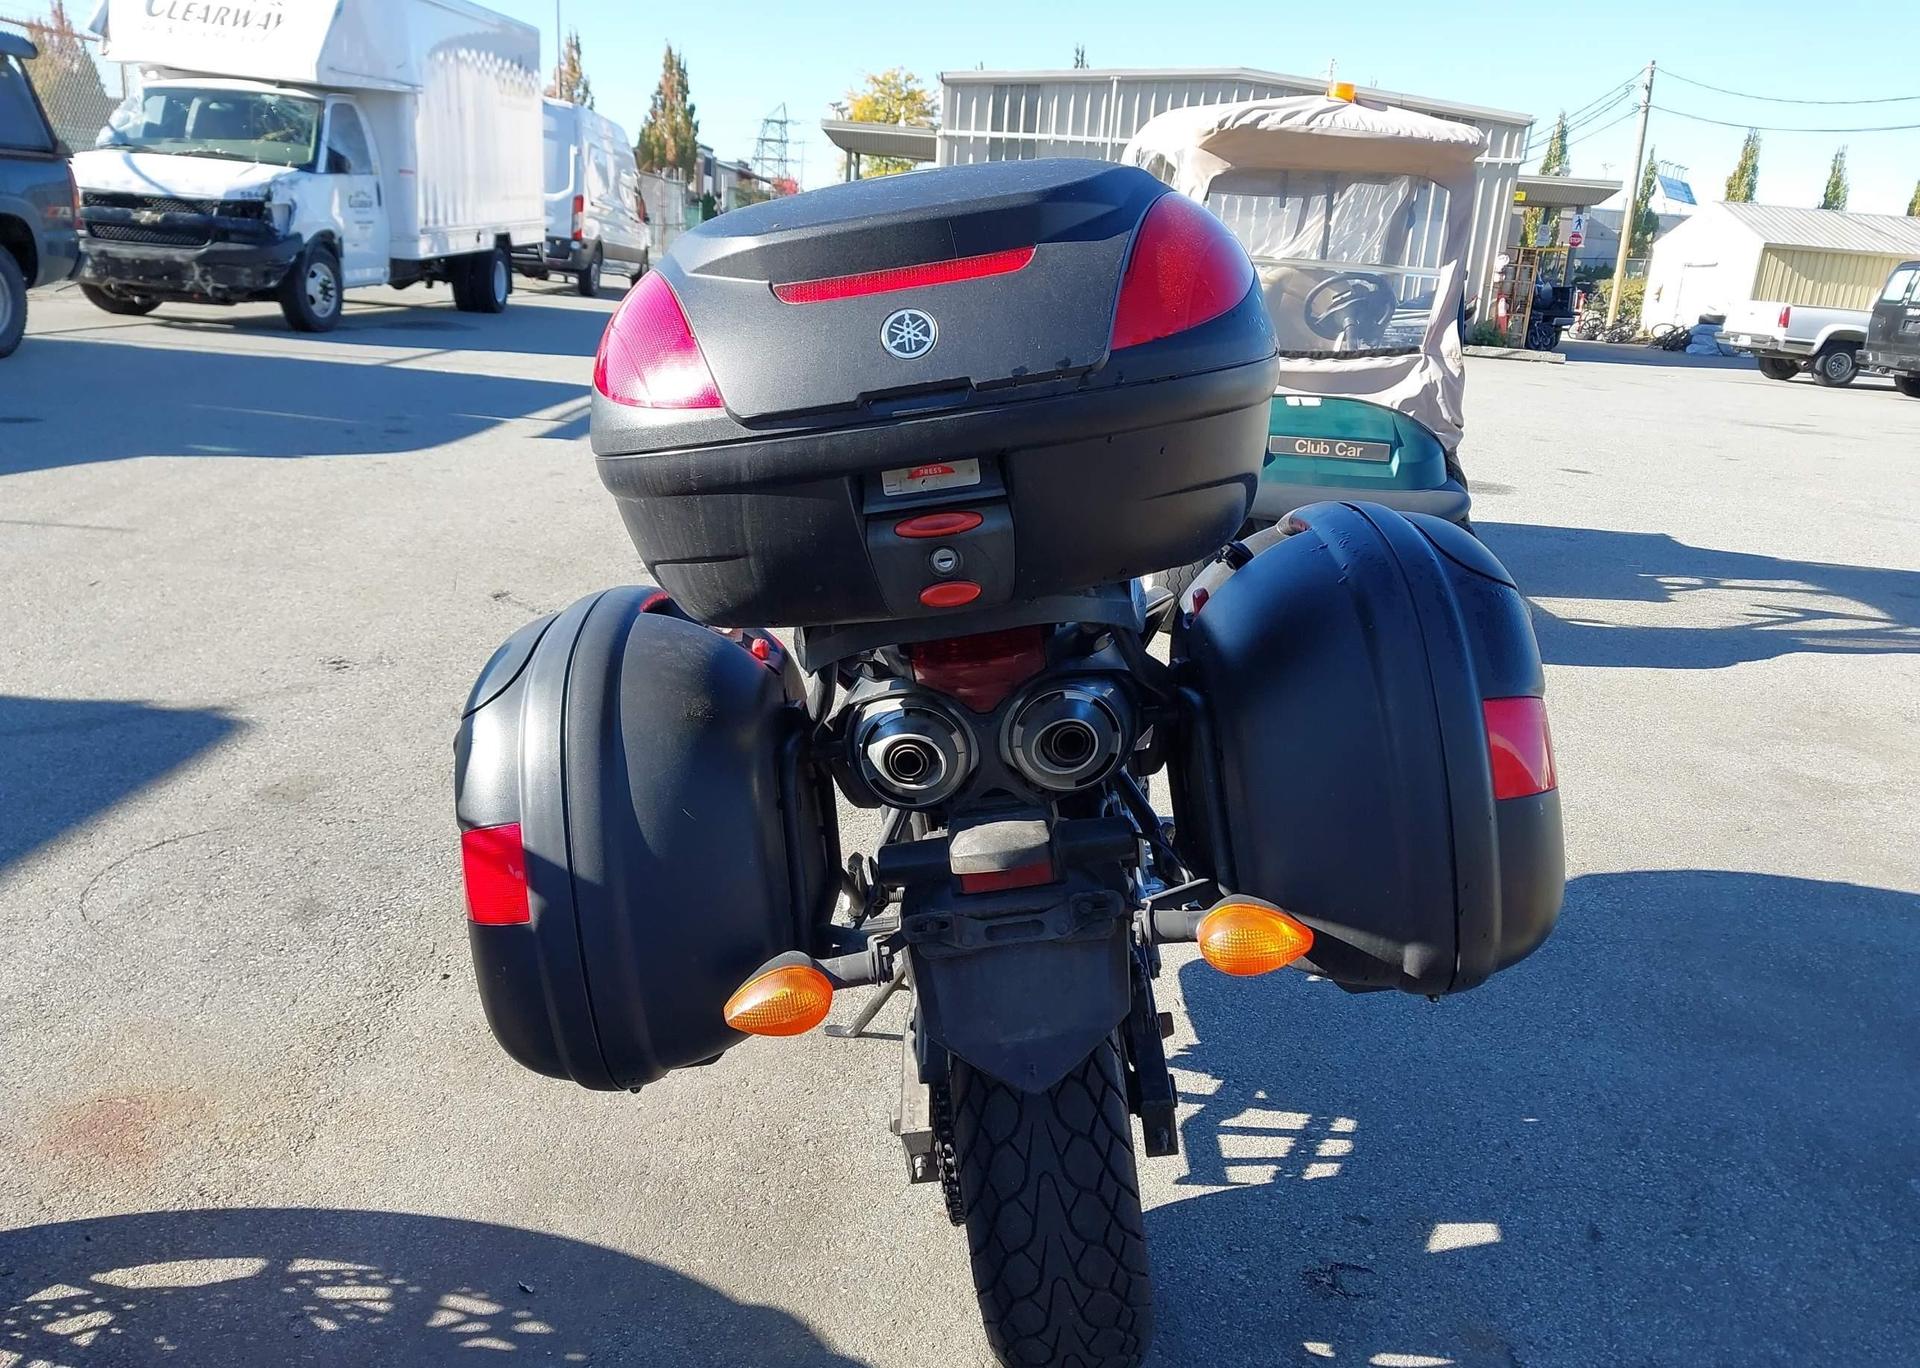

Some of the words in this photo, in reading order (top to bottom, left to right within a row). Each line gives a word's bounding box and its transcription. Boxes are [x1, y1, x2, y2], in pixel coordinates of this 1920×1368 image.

[145, 0, 284, 31] CLEARWAY
[1294, 439, 1330, 455] Club
[1335, 442, 1364, 457] Car
